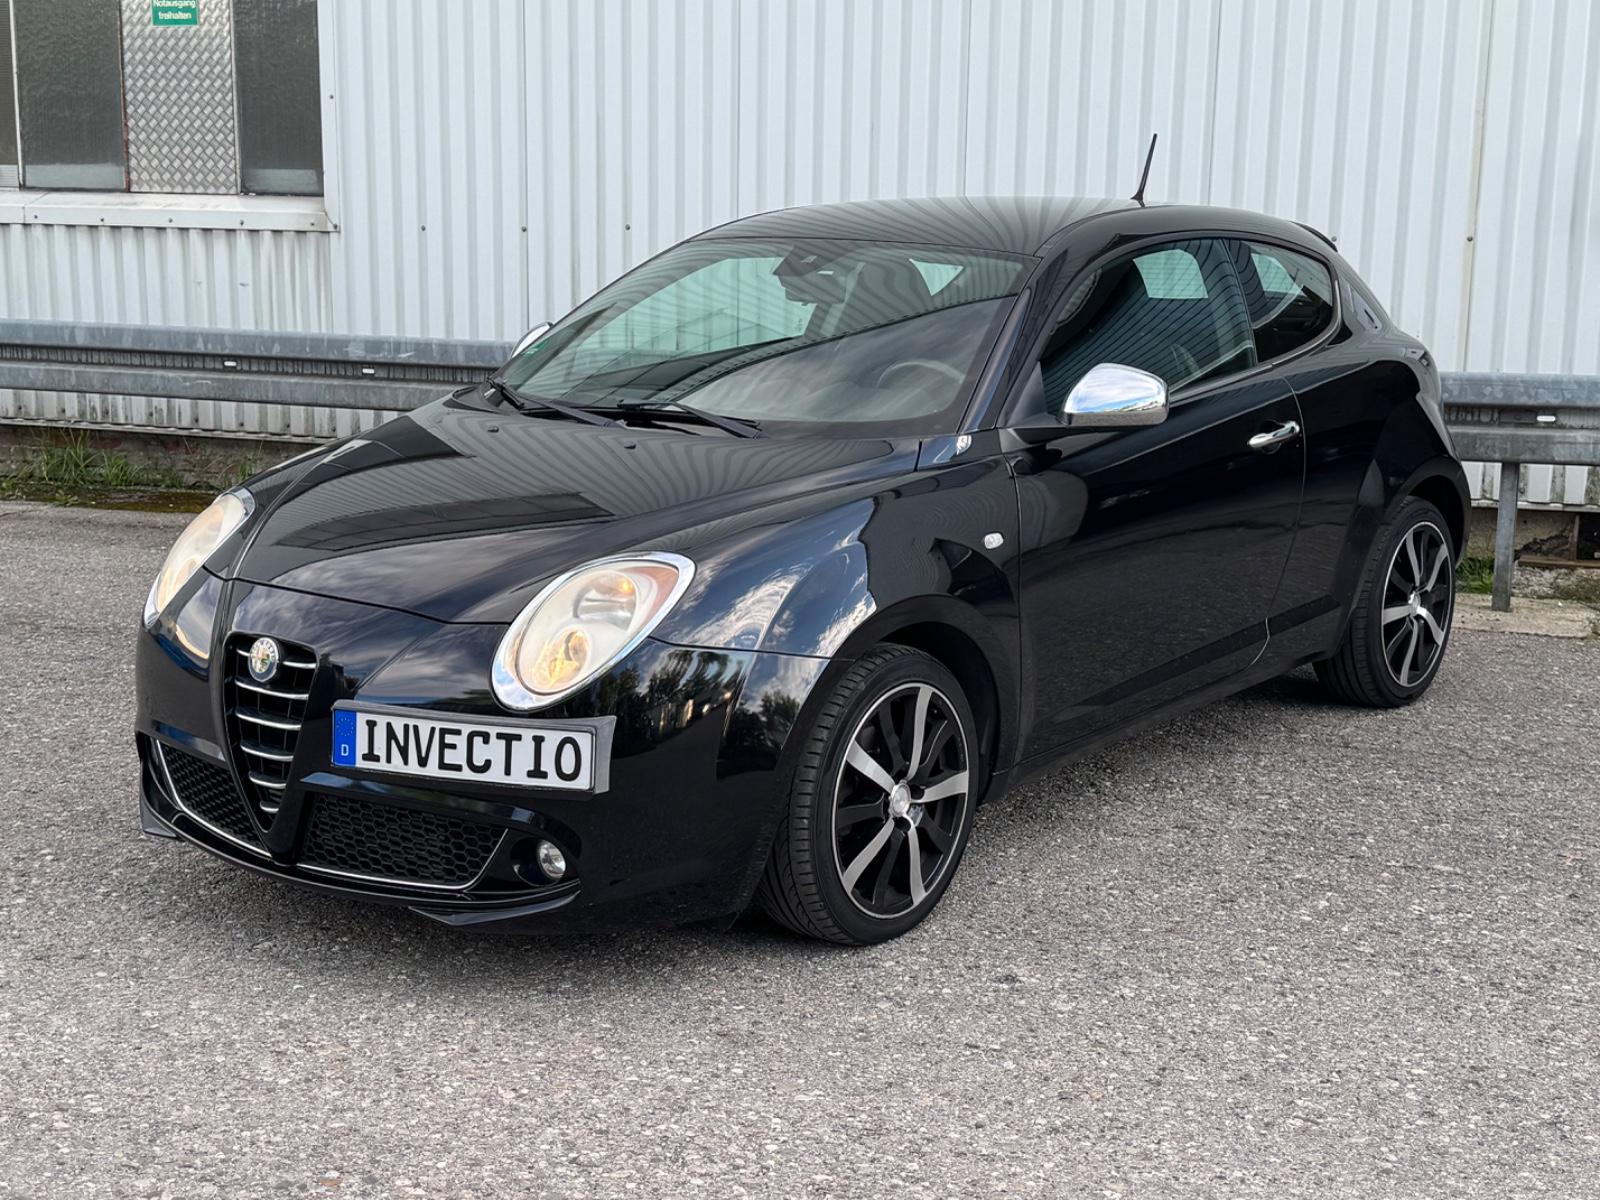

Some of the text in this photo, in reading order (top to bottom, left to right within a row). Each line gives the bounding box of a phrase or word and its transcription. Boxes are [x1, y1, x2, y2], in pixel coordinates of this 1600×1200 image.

[154, 0, 196, 8] Notausgang
[158, 11, 192, 20] freihalten
[341, 719, 582, 782] D INVECTIO
